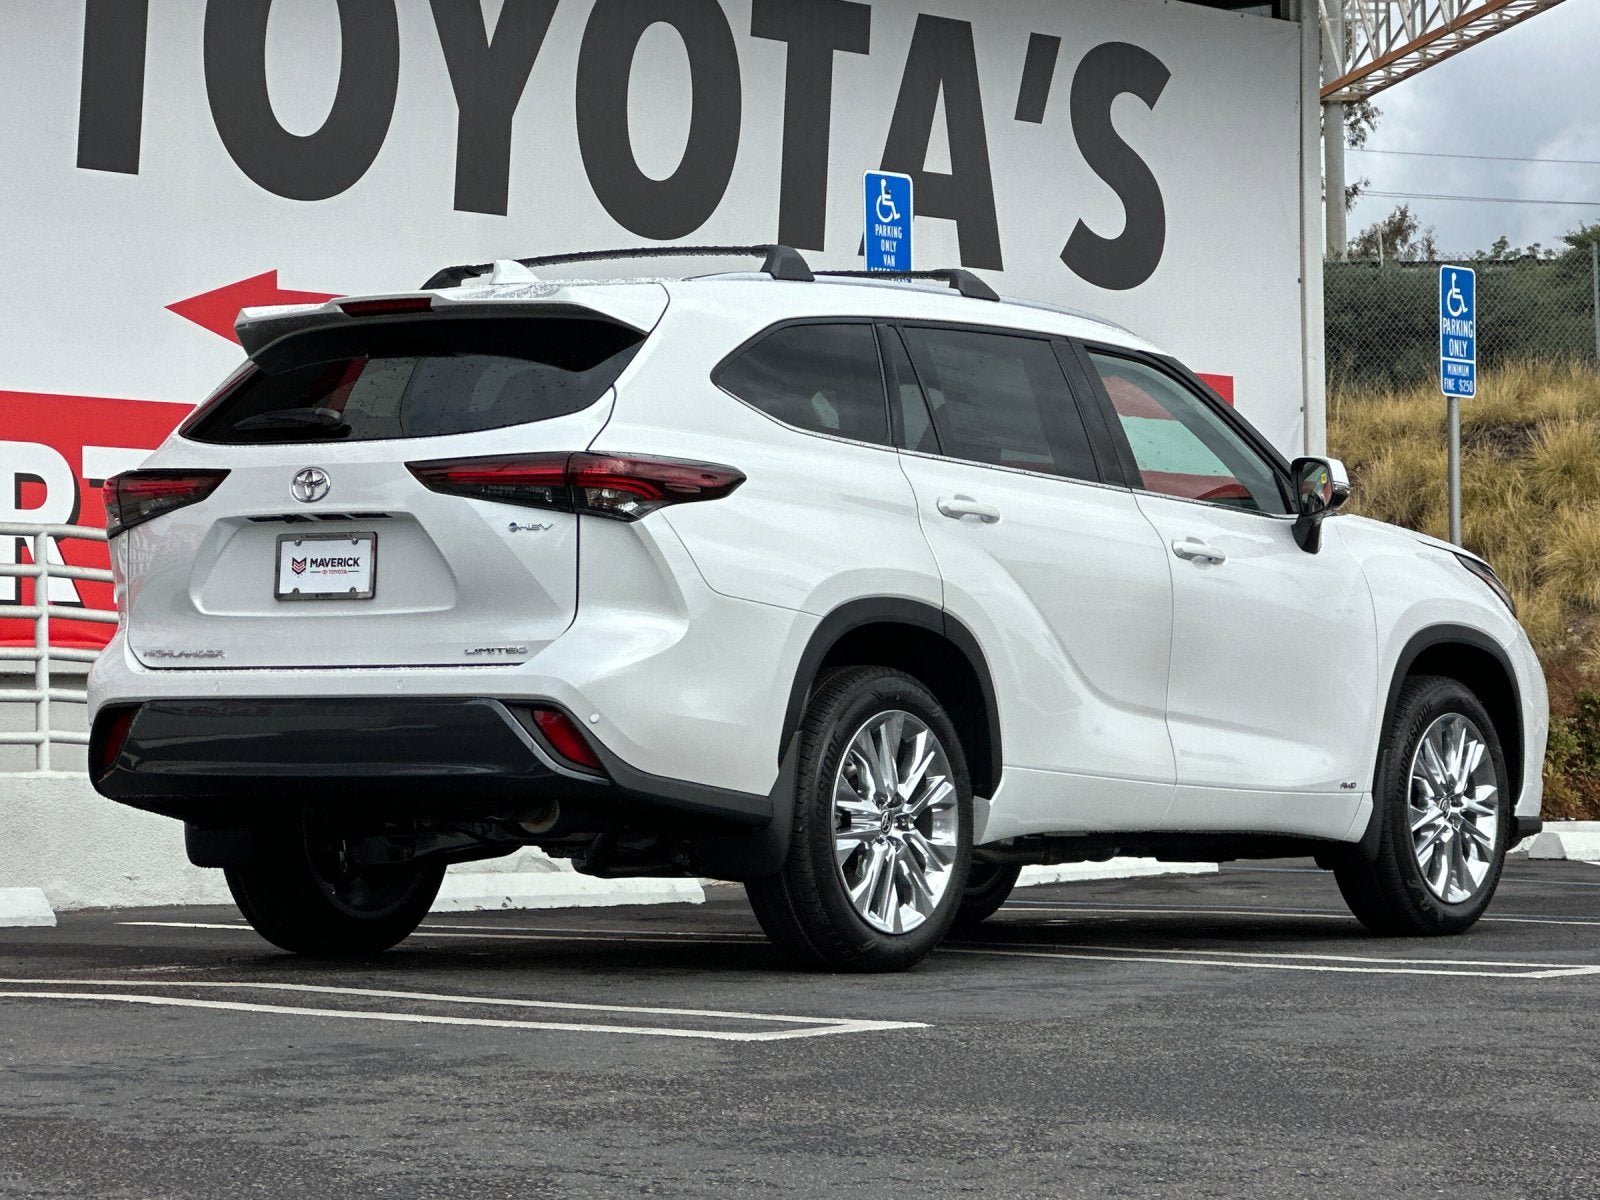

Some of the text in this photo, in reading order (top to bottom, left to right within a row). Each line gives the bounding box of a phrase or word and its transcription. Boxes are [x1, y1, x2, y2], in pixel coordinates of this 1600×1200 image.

[76, 0, 1171, 290] TOYOTA'S
[875, 224, 902, 239] PARKING
[880, 240, 897, 253] ONLY
[883, 254, 895, 267] VAN
[1443, 318, 1473, 338] PARKING
[1449, 339, 1468, 357] ONLY
[1447, 364, 1469, 376] MINIMUM
[1444, 378, 1473, 392] FINE $250
[310, 557, 360, 568] MAVERICK
[464, 646, 529, 656] LIMITED
